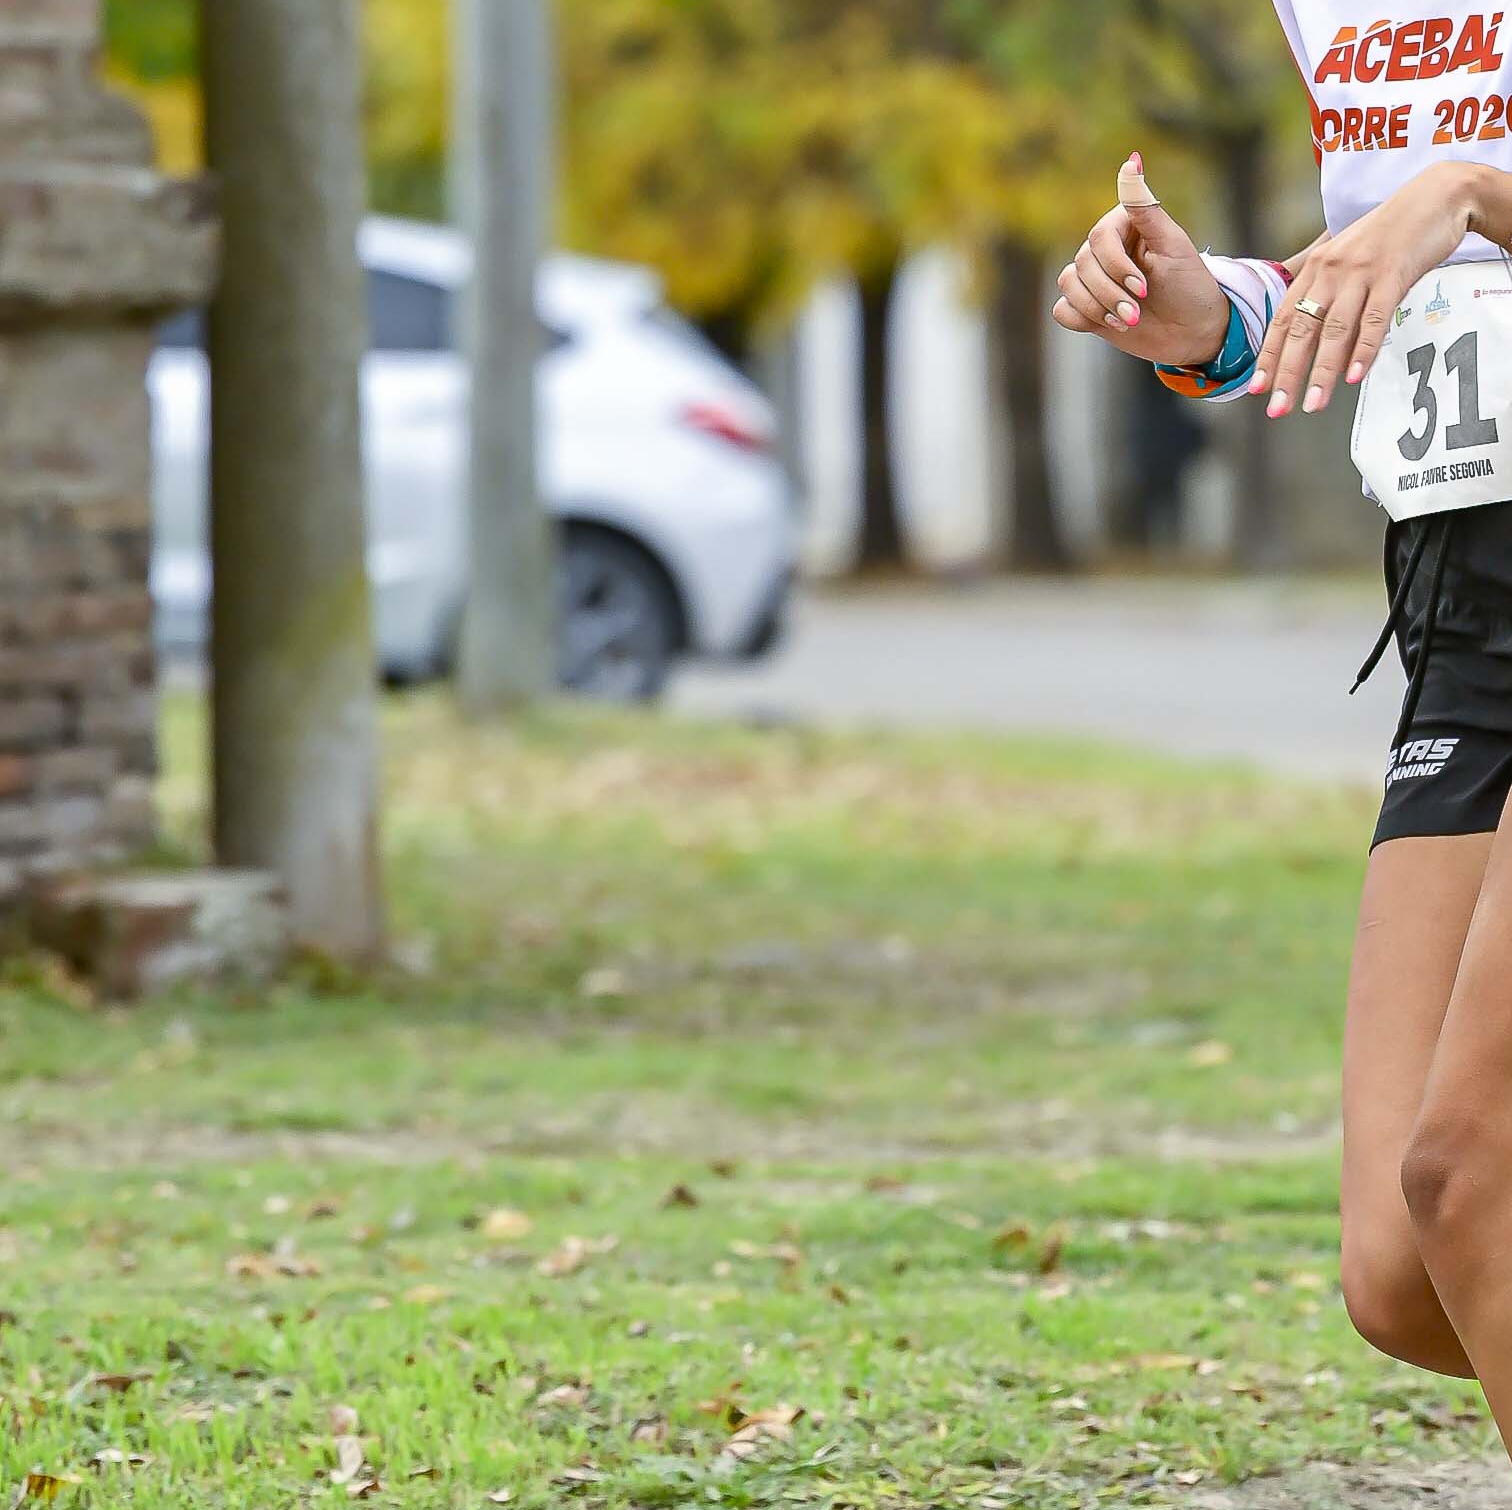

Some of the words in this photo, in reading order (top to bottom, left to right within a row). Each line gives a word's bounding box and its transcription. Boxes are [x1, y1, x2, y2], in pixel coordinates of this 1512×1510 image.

[1314, 11, 1504, 84] ACEBAL
[1320, 104, 1412, 152] ORRE
[1396, 331, 1500, 461] 31
[1397, 472, 1419, 492] NICOL
[1449, 458, 1495, 482] SEGOVIA
